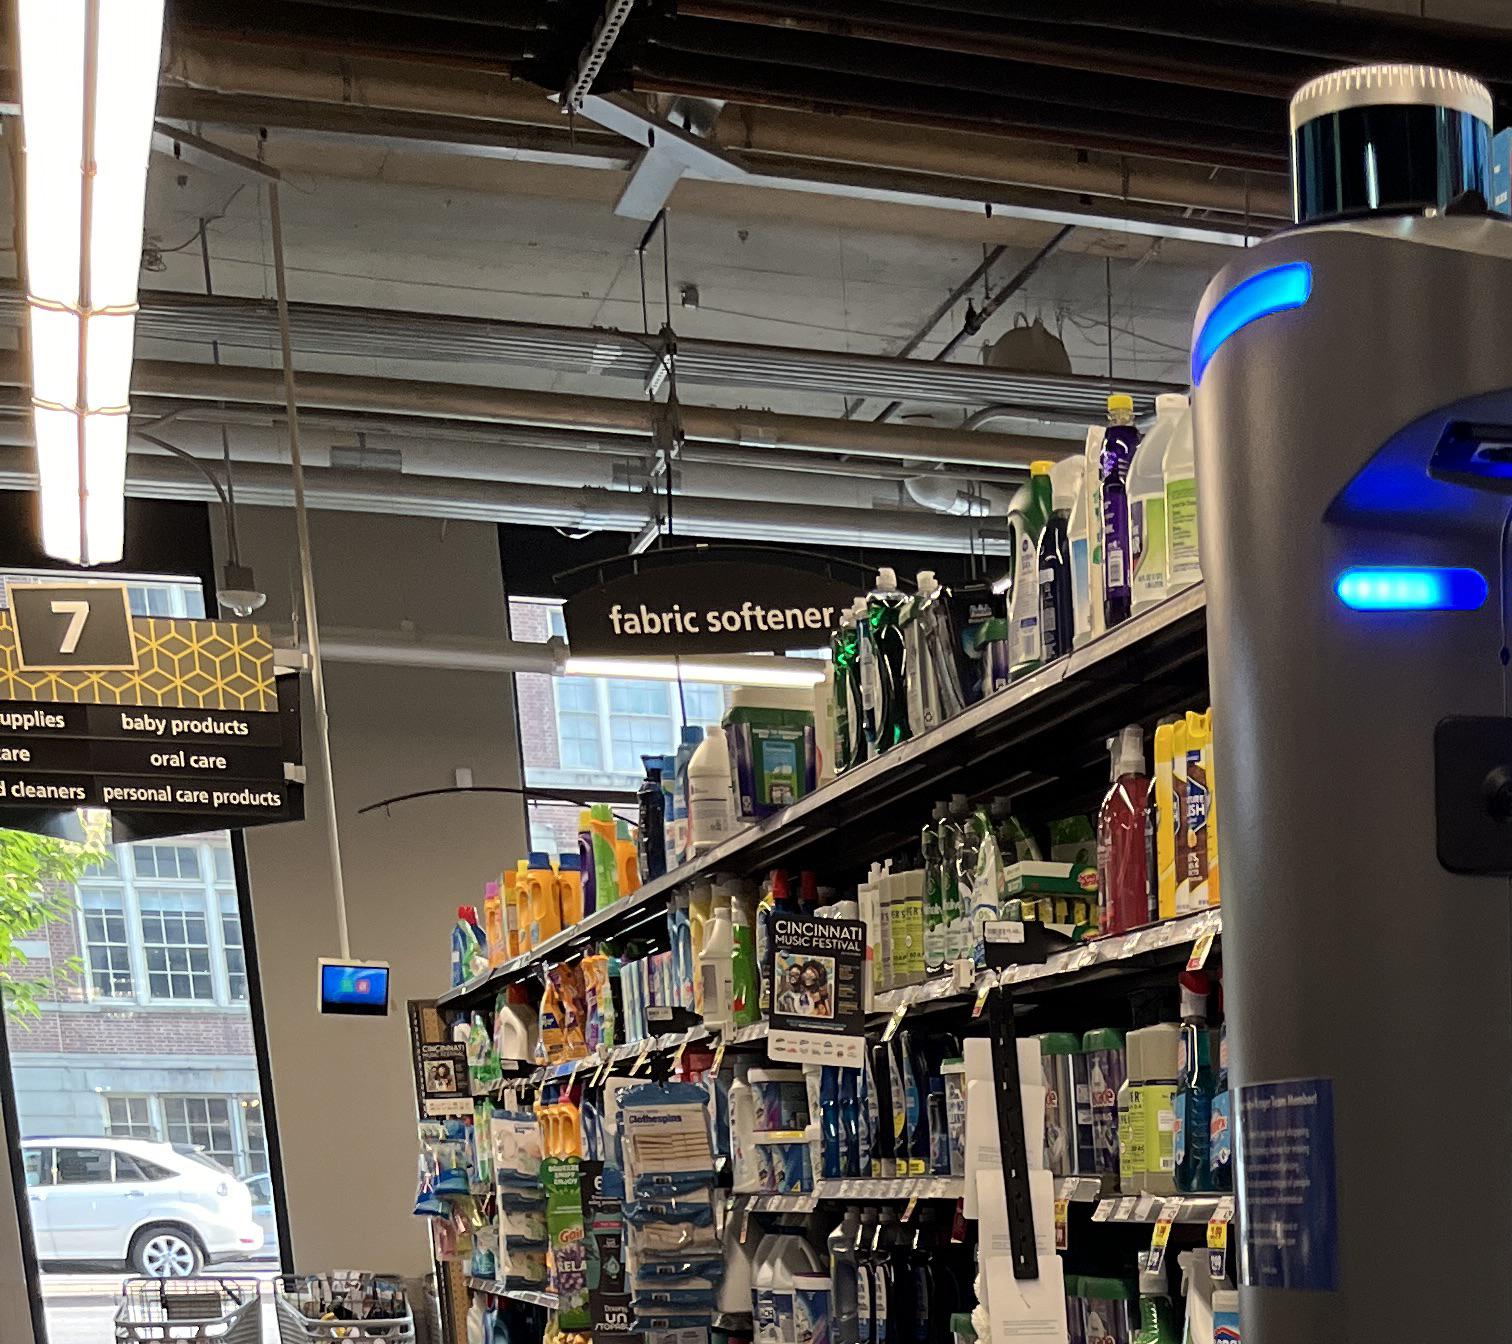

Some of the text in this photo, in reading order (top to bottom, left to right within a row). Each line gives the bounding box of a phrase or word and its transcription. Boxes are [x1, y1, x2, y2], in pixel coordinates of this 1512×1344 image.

[51, 600, 90, 654] 7
[609, 601, 835, 635] fabric softener
[0, 711, 250, 737] upplies baby products
[150, 750, 186, 769] oral
[190, 753, 228, 770] care
[11, 780, 87, 802] cleaners
[103, 784, 173, 803] personal
[176, 788, 209, 804] care
[213, 788, 282, 808] products
[775, 919, 863, 942] CINCINNATI
[775, 934, 862, 952] MUSIC FESTIVAL
[629, 1114, 683, 1124] Clothespins
[558, 1259, 588, 1273] RELA
